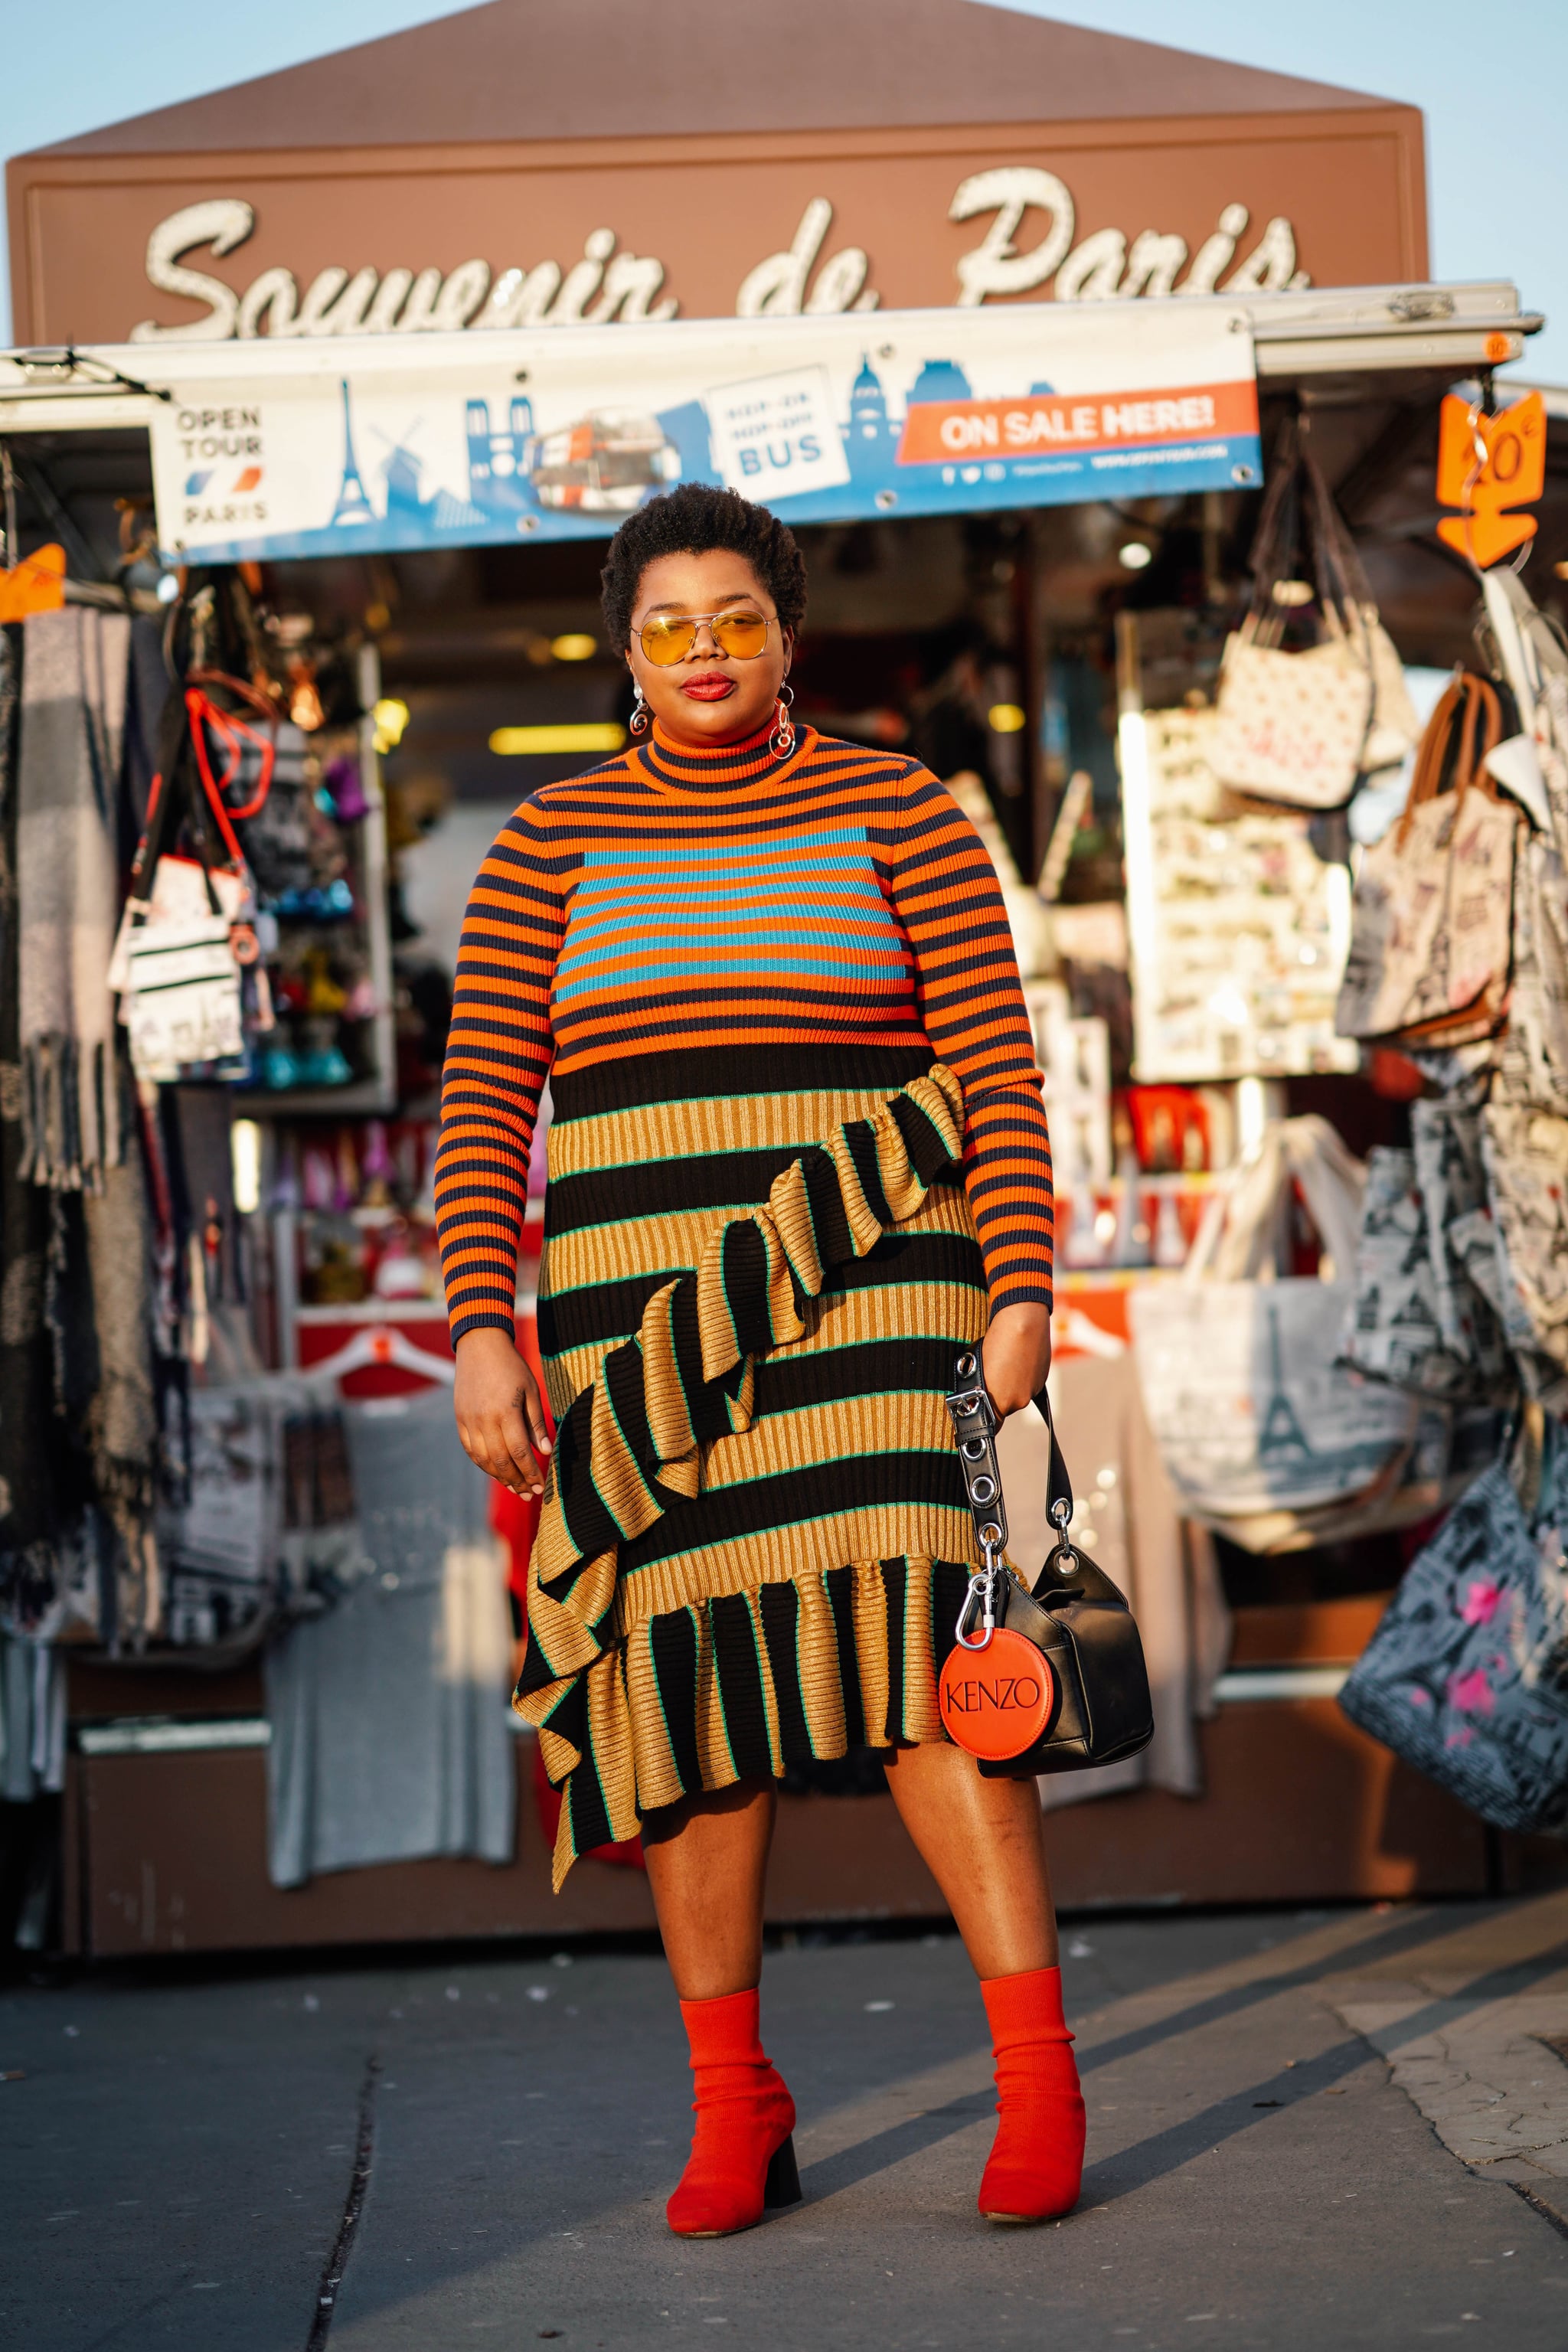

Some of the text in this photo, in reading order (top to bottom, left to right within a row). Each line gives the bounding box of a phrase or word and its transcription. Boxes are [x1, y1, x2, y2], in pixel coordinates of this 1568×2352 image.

[131, 167, 1311, 343] Souvenir de Paris
[177, 407, 260, 432] OPEN
[940, 396, 1215, 449] ON SALE HERE!
[181, 437, 262, 459] TOUR
[739, 435, 822, 475] BUS
[185, 501, 266, 524] PARIS
[946, 1677, 1040, 1713] KENZO
